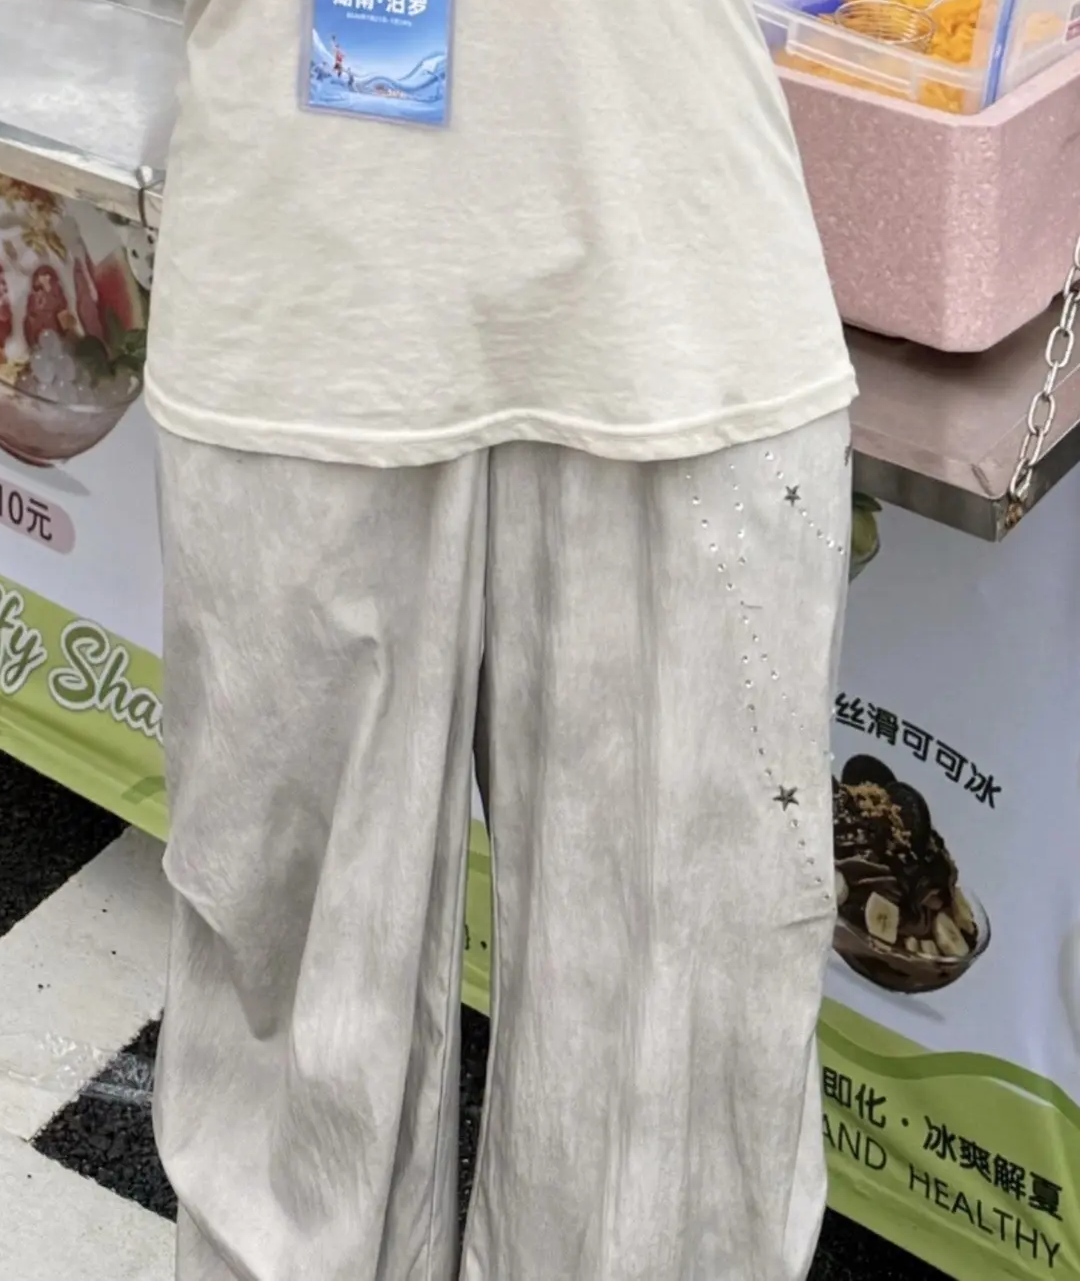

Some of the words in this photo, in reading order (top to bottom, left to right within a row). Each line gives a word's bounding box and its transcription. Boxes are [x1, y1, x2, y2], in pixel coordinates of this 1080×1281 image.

[47, 622, 165, 743] Sha
[835, 692, 1002, 809] 丝滑可可冰
[821, 1113, 887, 1171] AND
[907, 1164, 1060, 1270] HEALTHY
